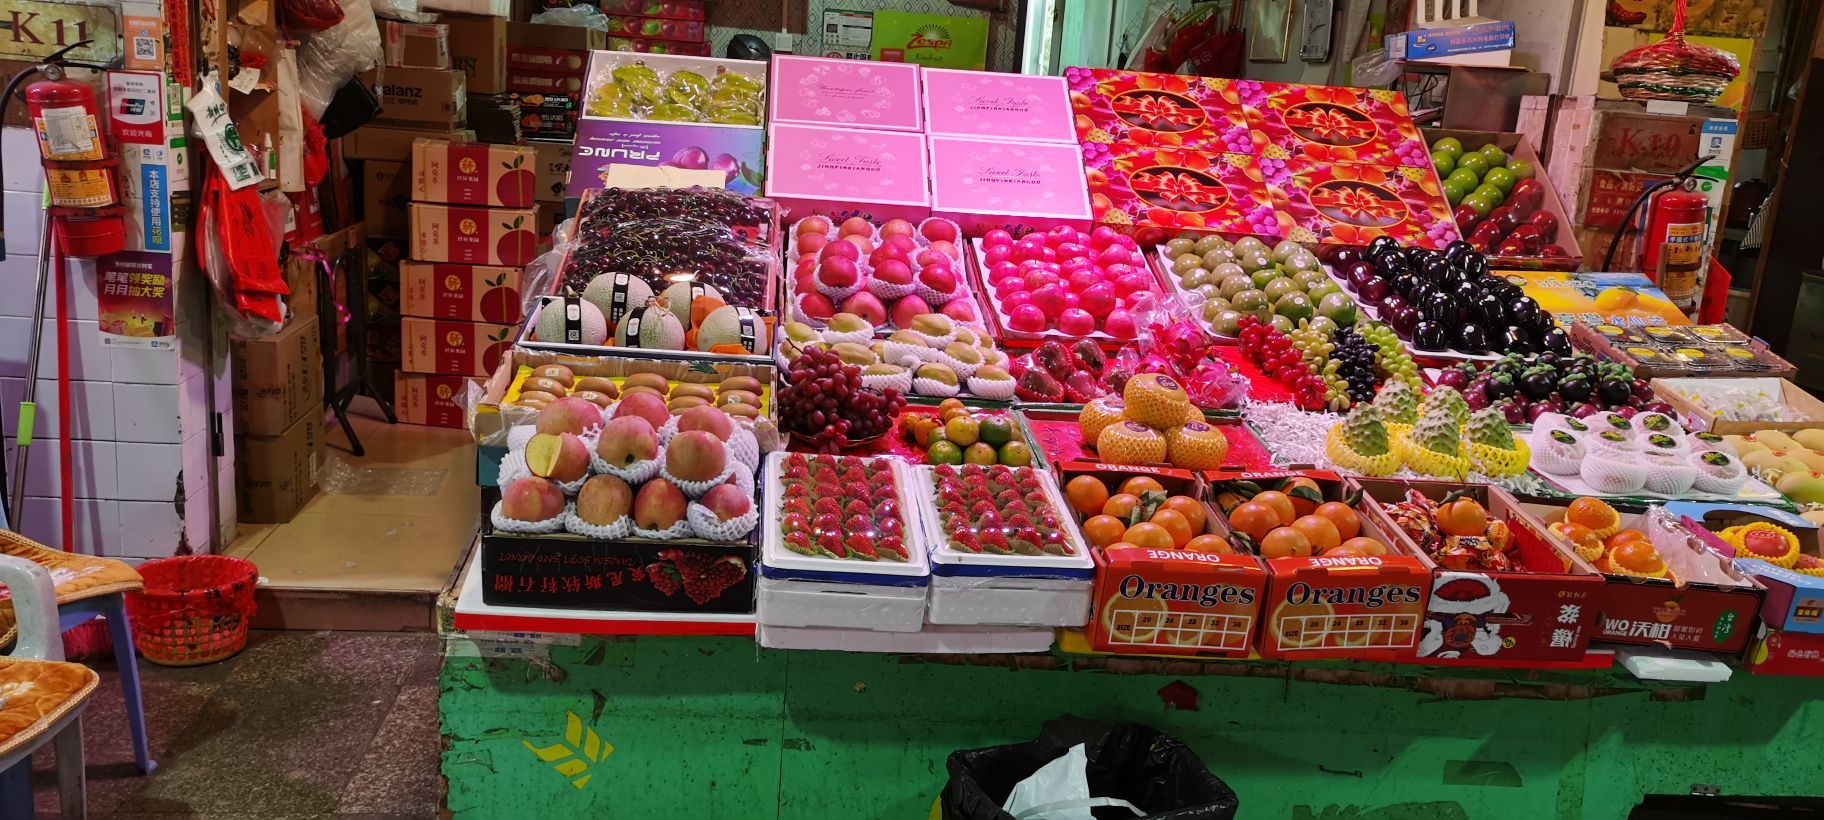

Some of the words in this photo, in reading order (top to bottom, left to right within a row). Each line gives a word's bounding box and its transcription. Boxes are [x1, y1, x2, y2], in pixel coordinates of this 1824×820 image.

[906, 33, 952, 51] Zespri
[578, 145, 660, 160] PRUNE
[148, 170, 162, 245] 本店支持使用花呗
[105, 271, 165, 286] 笔笔领奖励
[104, 283, 165, 298] 月月抽大奖
[1095, 463, 1161, 474] ORANGE
[1241, 470, 1306, 478] ORANGE
[1148, 549, 1220, 562] ORANGE
[1308, 557, 1383, 567] ORANGE
[1118, 574, 1256, 607] Oranges
[1286, 582, 1421, 608] Oranges
[1605, 618, 1629, 631] WO
[1629, 620, 1672, 640] 沃柑
[1602, 629, 1628, 637] ORANGE
